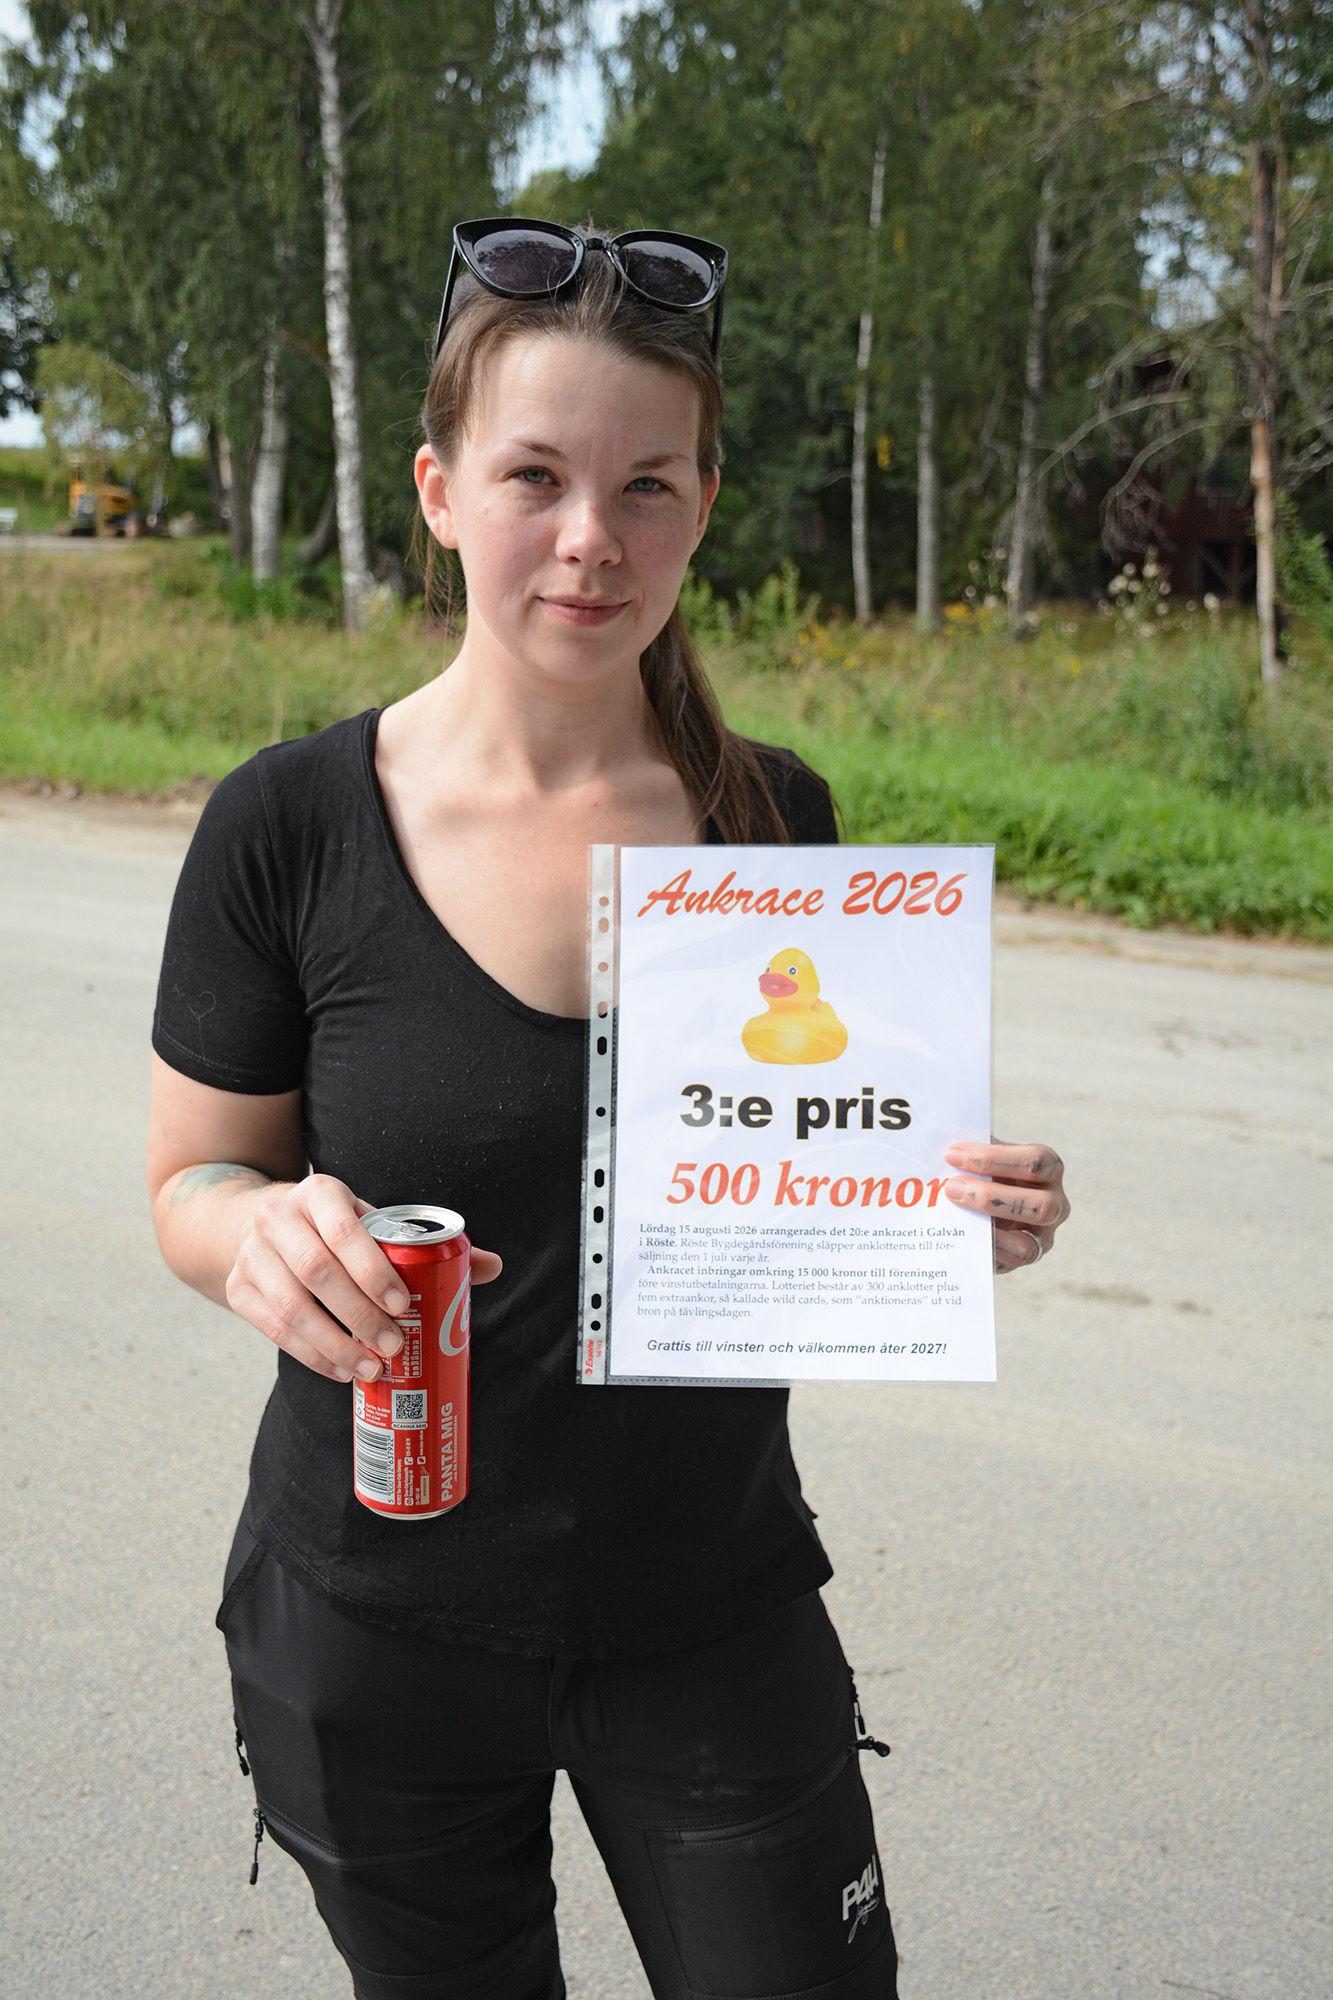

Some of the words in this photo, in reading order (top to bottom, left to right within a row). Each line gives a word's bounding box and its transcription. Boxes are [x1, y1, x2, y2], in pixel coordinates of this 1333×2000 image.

[637, 868, 825, 918] Ankrace
[841, 870, 969, 917] 2026
[680, 1083, 773, 1128] 3:e
[796, 1087, 912, 1140] pris
[666, 1162, 761, 1207] 500
[774, 1160, 949, 1208] kronor
[639, 1224, 676, 1238] Lördag
[680, 1225, 690, 1236] 15
[693, 1225, 731, 1237] augusti
[735, 1225, 758, 1235] 2026
[760, 1227, 828, 1238] arrangerades
[830, 1226, 847, 1237] det
[850, 1227, 870, 1237] 20:e
[872, 1227, 917, 1237] ankracet
[927, 1227, 965, 1237] Galvån
[646, 1237, 678, 1247] Röste.
[681, 1237, 709, 1248] Röste
[712, 1238, 814, 1251] Bygdegårdsförening
[817, 1240, 855, 1252] släpper
[857, 1240, 916, 1251] anklotterna
[919, 1240, 933, 1251] till
[638, 1251, 678, 1264] säljning
[681, 1251, 700, 1262] den
[711, 1252, 728, 1263] juli
[731, 1253, 756, 1264] varje
[758, 1253, 770, 1263] år.
[648, 1265, 694, 1275] Ankracet
[698, 1266, 747, 1280] inbringar
[749, 1267, 794, 1280] omkring
[798, 1268, 809, 1277] 15
[811, 1268, 829, 1277] 000
[832, 1268, 867, 1278] kronor
[871, 1268, 886, 1278] till
[889, 1268, 948, 1281] föreningen
[639, 1279, 658, 1290] före
[661, 1280, 769, 1291] vinstutbetalningarna.
[772, 1280, 815, 1291] Lotteriet
[818, 1280, 850, 1291] består
[851, 1283, 864, 1291] av
[867, 1281, 885, 1292] 300
[887, 1281, 935, 1291] anklotter
[937, 1282, 960, 1294] plus
[638, 1291, 658, 1302] fem
[660, 1293, 717, 1304] extraankor,
[719, 1293, 730, 1303] så
[733, 1293, 770, 1304] kallade
[773, 1294, 796, 1305] wild
[798, 1294, 829, 1305] cards,
[831, 1297, 853, 1305] som
[931, 1295, 941, 1305] ut
[945, 1295, 962, 1306] vid
[637, 1305, 661, 1316] bron
[664, 1307, 677, 1318] på
[679, 1307, 753, 1320] tävlingsdagen.
[585, 1339, 594, 1368] Esselte
[646, 1340, 691, 1351] Grattis
[696, 1340, 713, 1352] till
[716, 1341, 765, 1352] vinsten
[769, 1341, 794, 1353] och
[798, 1342, 876, 1354] välkommen
[880, 1342, 908, 1354] åter
[911, 1343, 948, 1354] 2027!
[441, 1402, 453, 1440] MIG
[441, 1440, 453, 1502] PANTA
